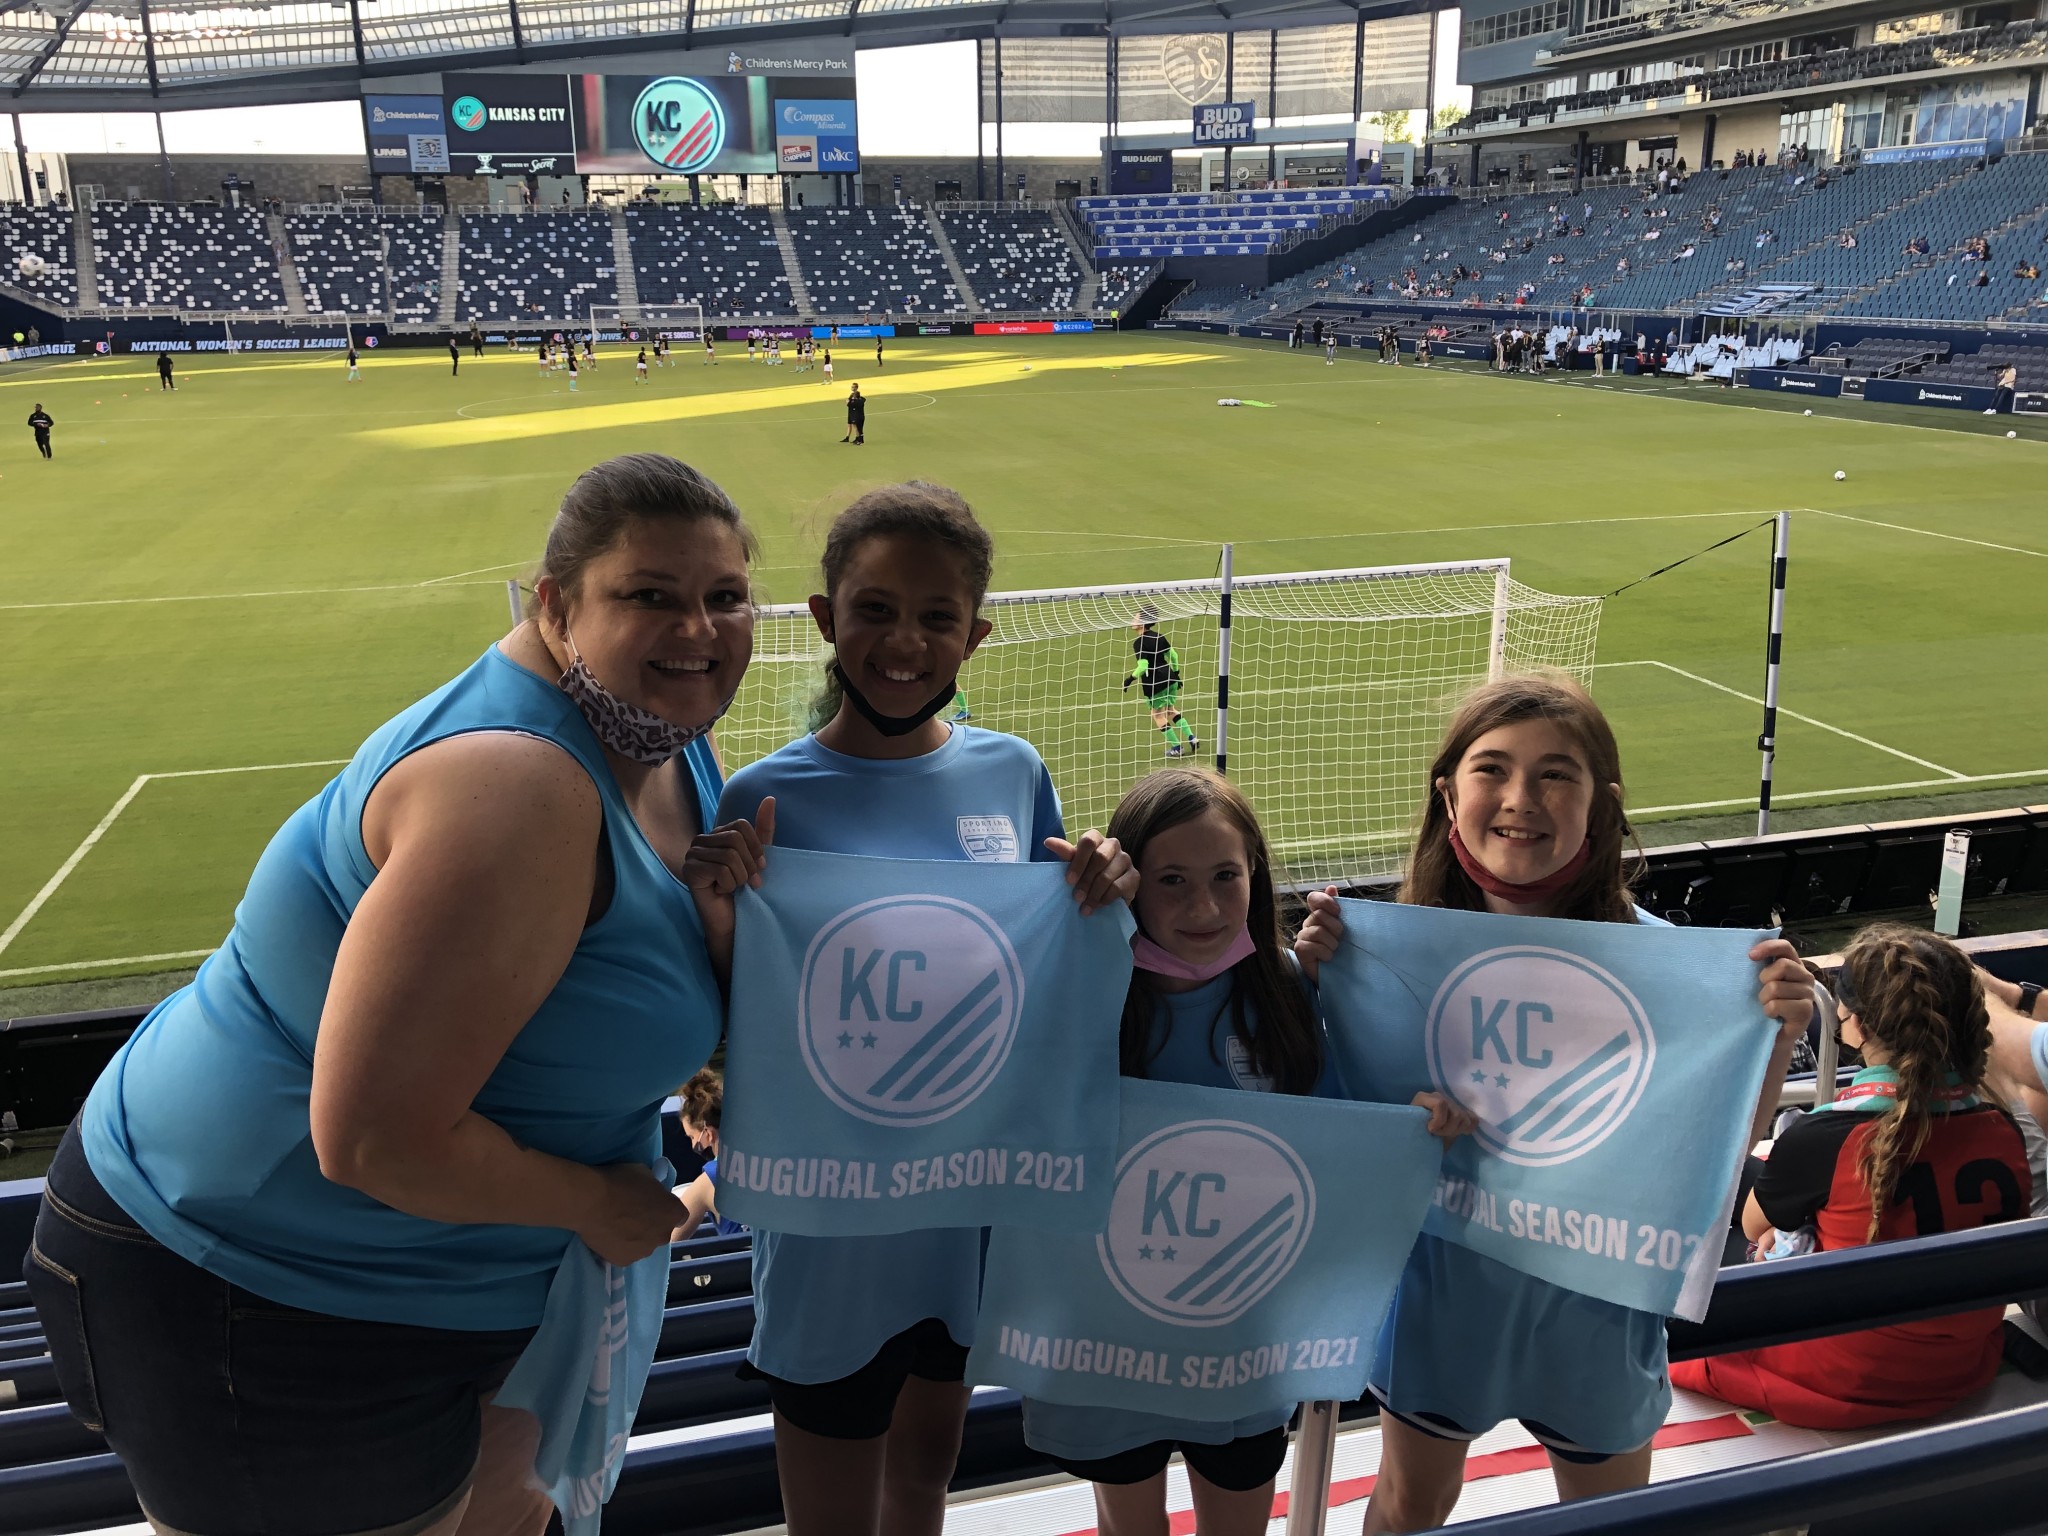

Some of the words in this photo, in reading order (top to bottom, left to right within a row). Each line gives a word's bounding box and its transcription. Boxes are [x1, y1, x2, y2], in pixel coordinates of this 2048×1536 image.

[745, 58, 792, 69] Children's
[793, 59, 823, 71] Mercy
[825, 59, 848, 69] Park
[386, 111, 418, 119] Children's
[418, 112, 440, 120] Mercy
[458, 105, 472, 117] KC
[489, 107, 536, 121] KANSAS
[539, 108, 565, 121] CITY
[647, 101, 681, 131] KC
[793, 110, 835, 124] Compass
[1203, 107, 1242, 123] BUD
[817, 121, 846, 129] Minerals
[1196, 122, 1249, 140] LIGHT
[373, 148, 407, 157] UMB
[784, 151, 812, 162] CHOPPER
[822, 150, 853, 162] UMKC
[529, 158, 557, 173] Secret
[130, 341, 192, 351] NATIONAL
[196, 339, 253, 350] WOMEN'S
[256, 339, 300, 349] SOCCER
[303, 338, 347, 348] LEAGUE
[963, 820, 1008, 828] SPORTING
[839, 947, 927, 1022] KC
[1470, 995, 1553, 1070] KC
[889, 1148, 1006, 1199] SEASON
[1015, 1150, 1085, 1193] 2021
[1141, 1169, 1226, 1238] KC
[1508, 1199, 1629, 1261] SEASON
[1634, 1224, 1704, 1274] 202
[998, 1325, 1173, 1386] INAUGURAL
[1180, 1341, 1289, 1389] SEASON
[1293, 1336, 1360, 1373] 2021
